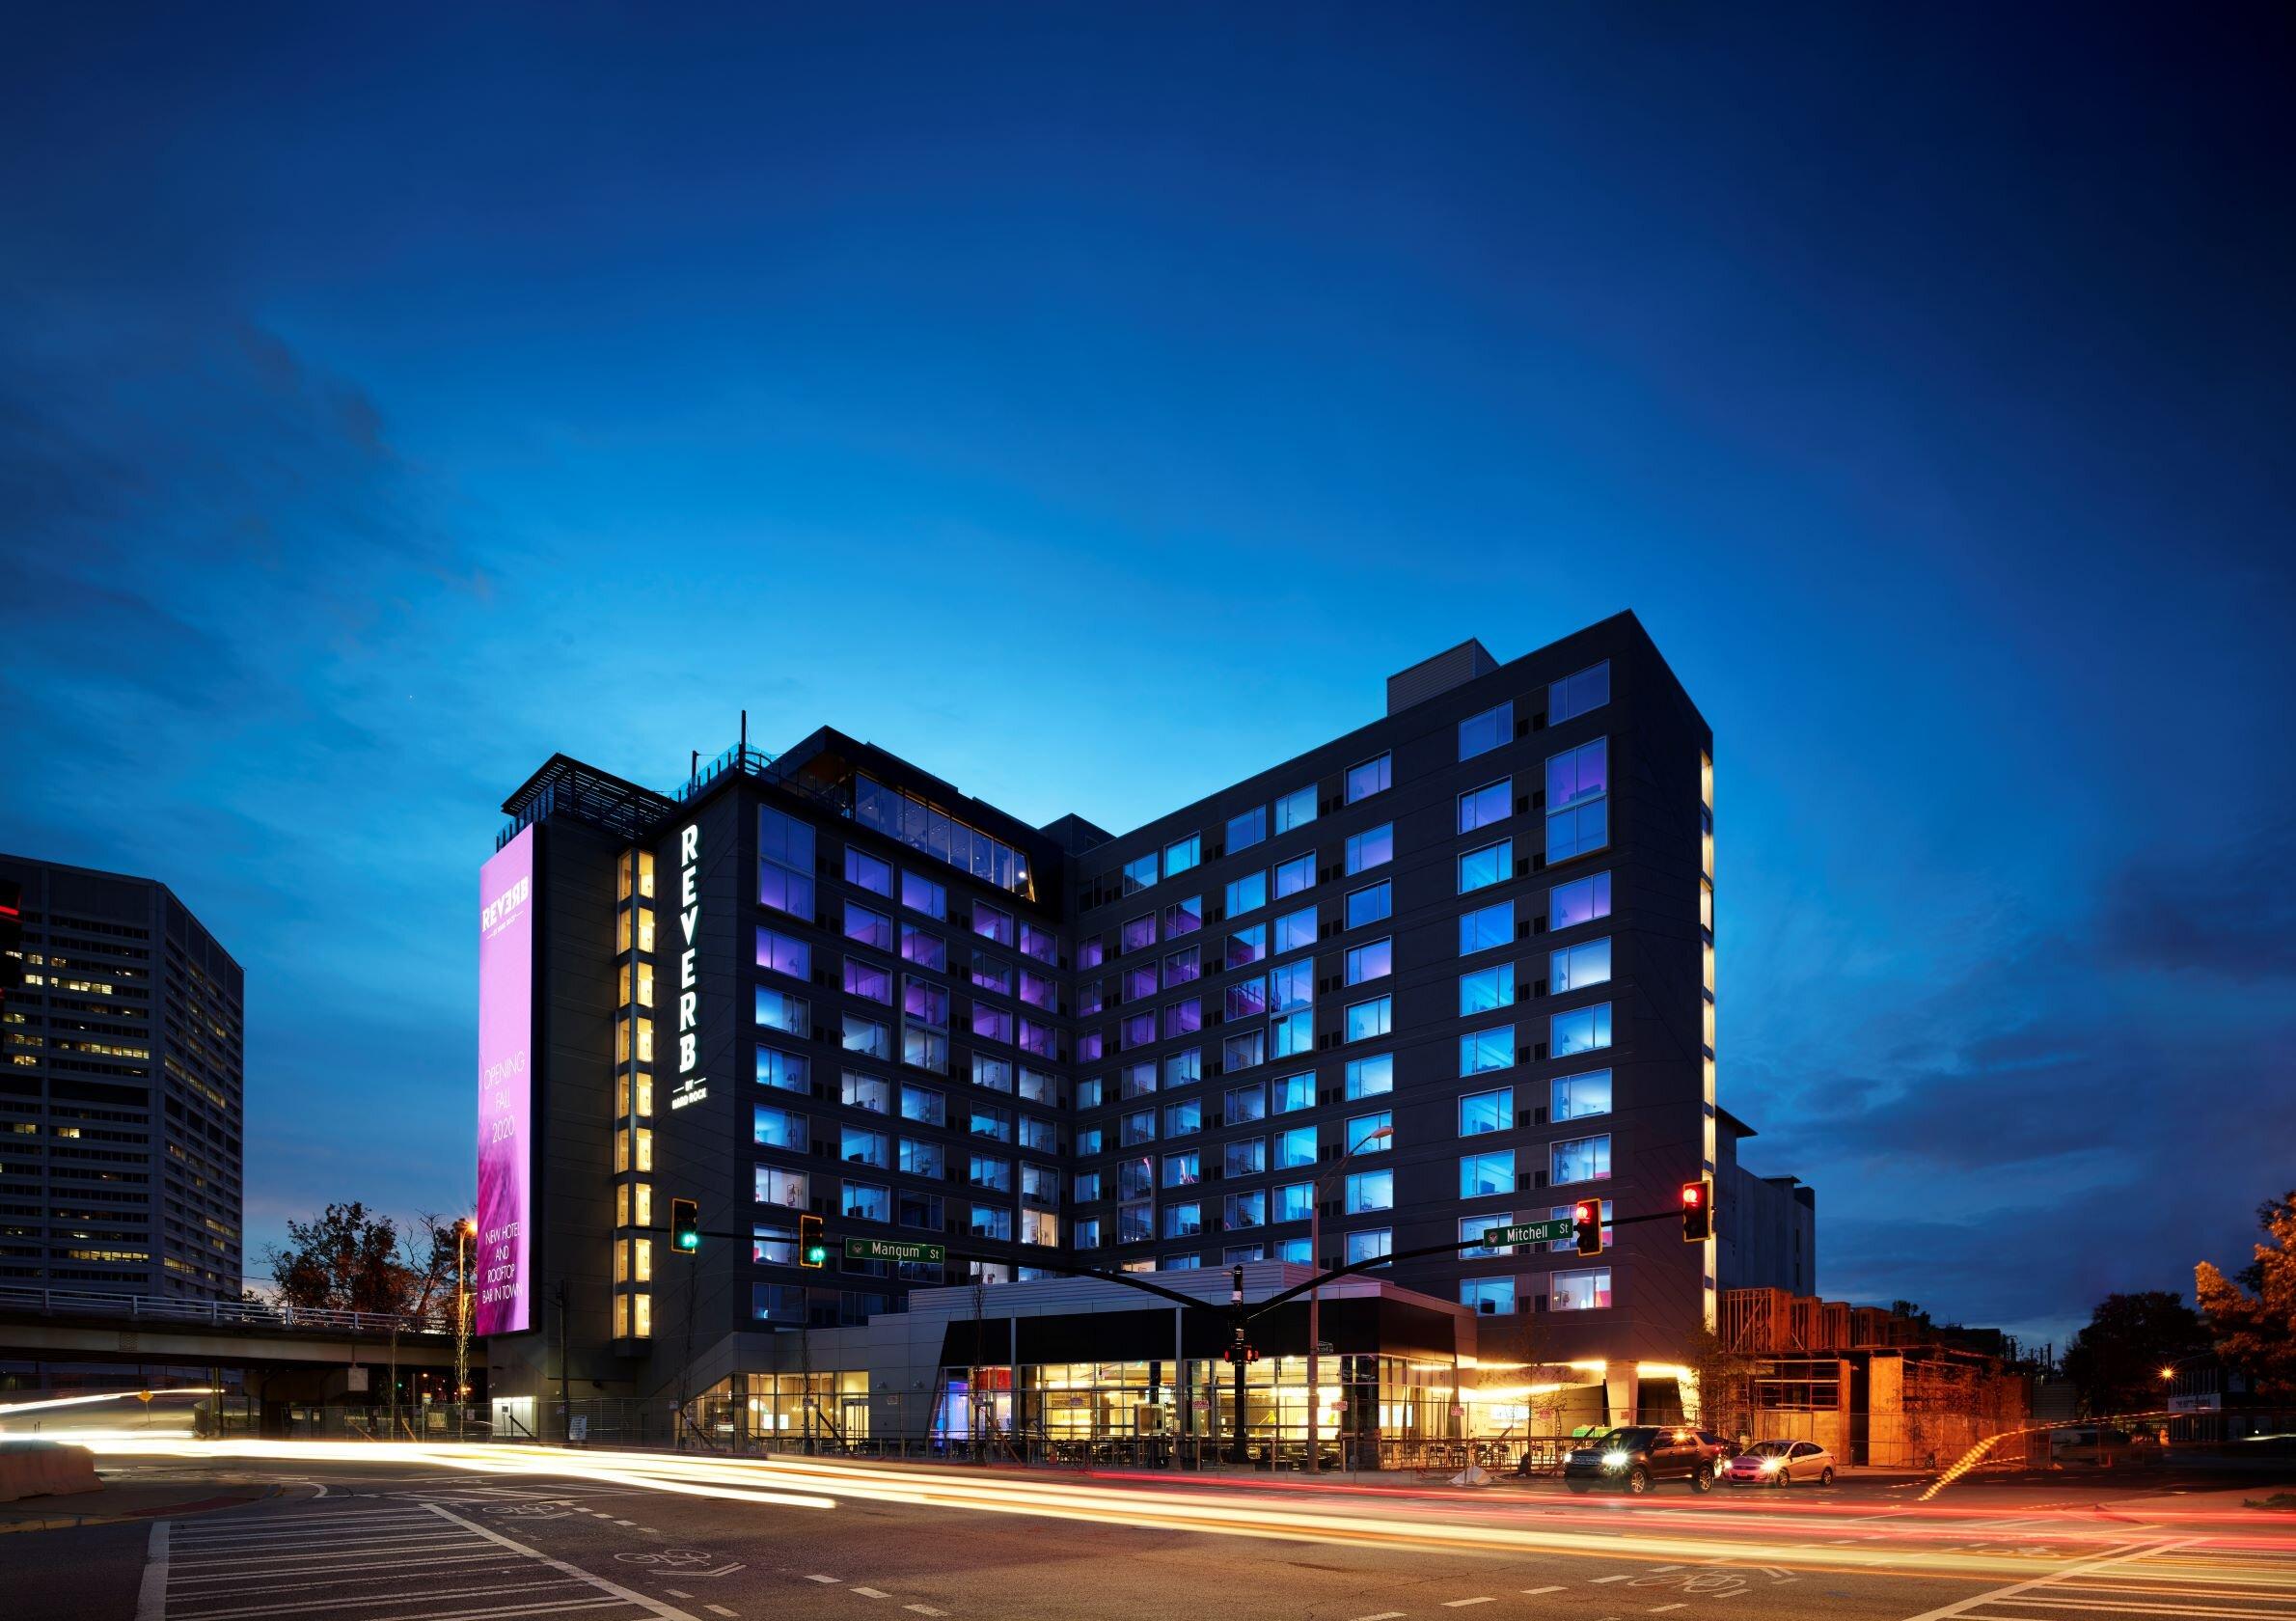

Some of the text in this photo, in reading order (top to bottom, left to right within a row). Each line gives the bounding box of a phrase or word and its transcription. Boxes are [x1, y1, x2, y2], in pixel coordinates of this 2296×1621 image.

[482, 875, 529, 933] REVERB
[680, 824, 698, 1074] REVERB
[483, 1050, 525, 1090] OPENING
[495, 1087, 510, 1113] FALL
[689, 1087, 707, 1103] ROCK
[492, 1114, 515, 1143] 2020
[485, 1222, 521, 1245] NEW HOTEL
[1507, 1223, 1569, 1243] Mitchell St
[495, 1245, 509, 1262] AND
[872, 1241, 940, 1260] Mangum St
[487, 1263, 515, 1283] ROOFTOP
[482, 1282, 523, 1305] BAR IN TOWN
